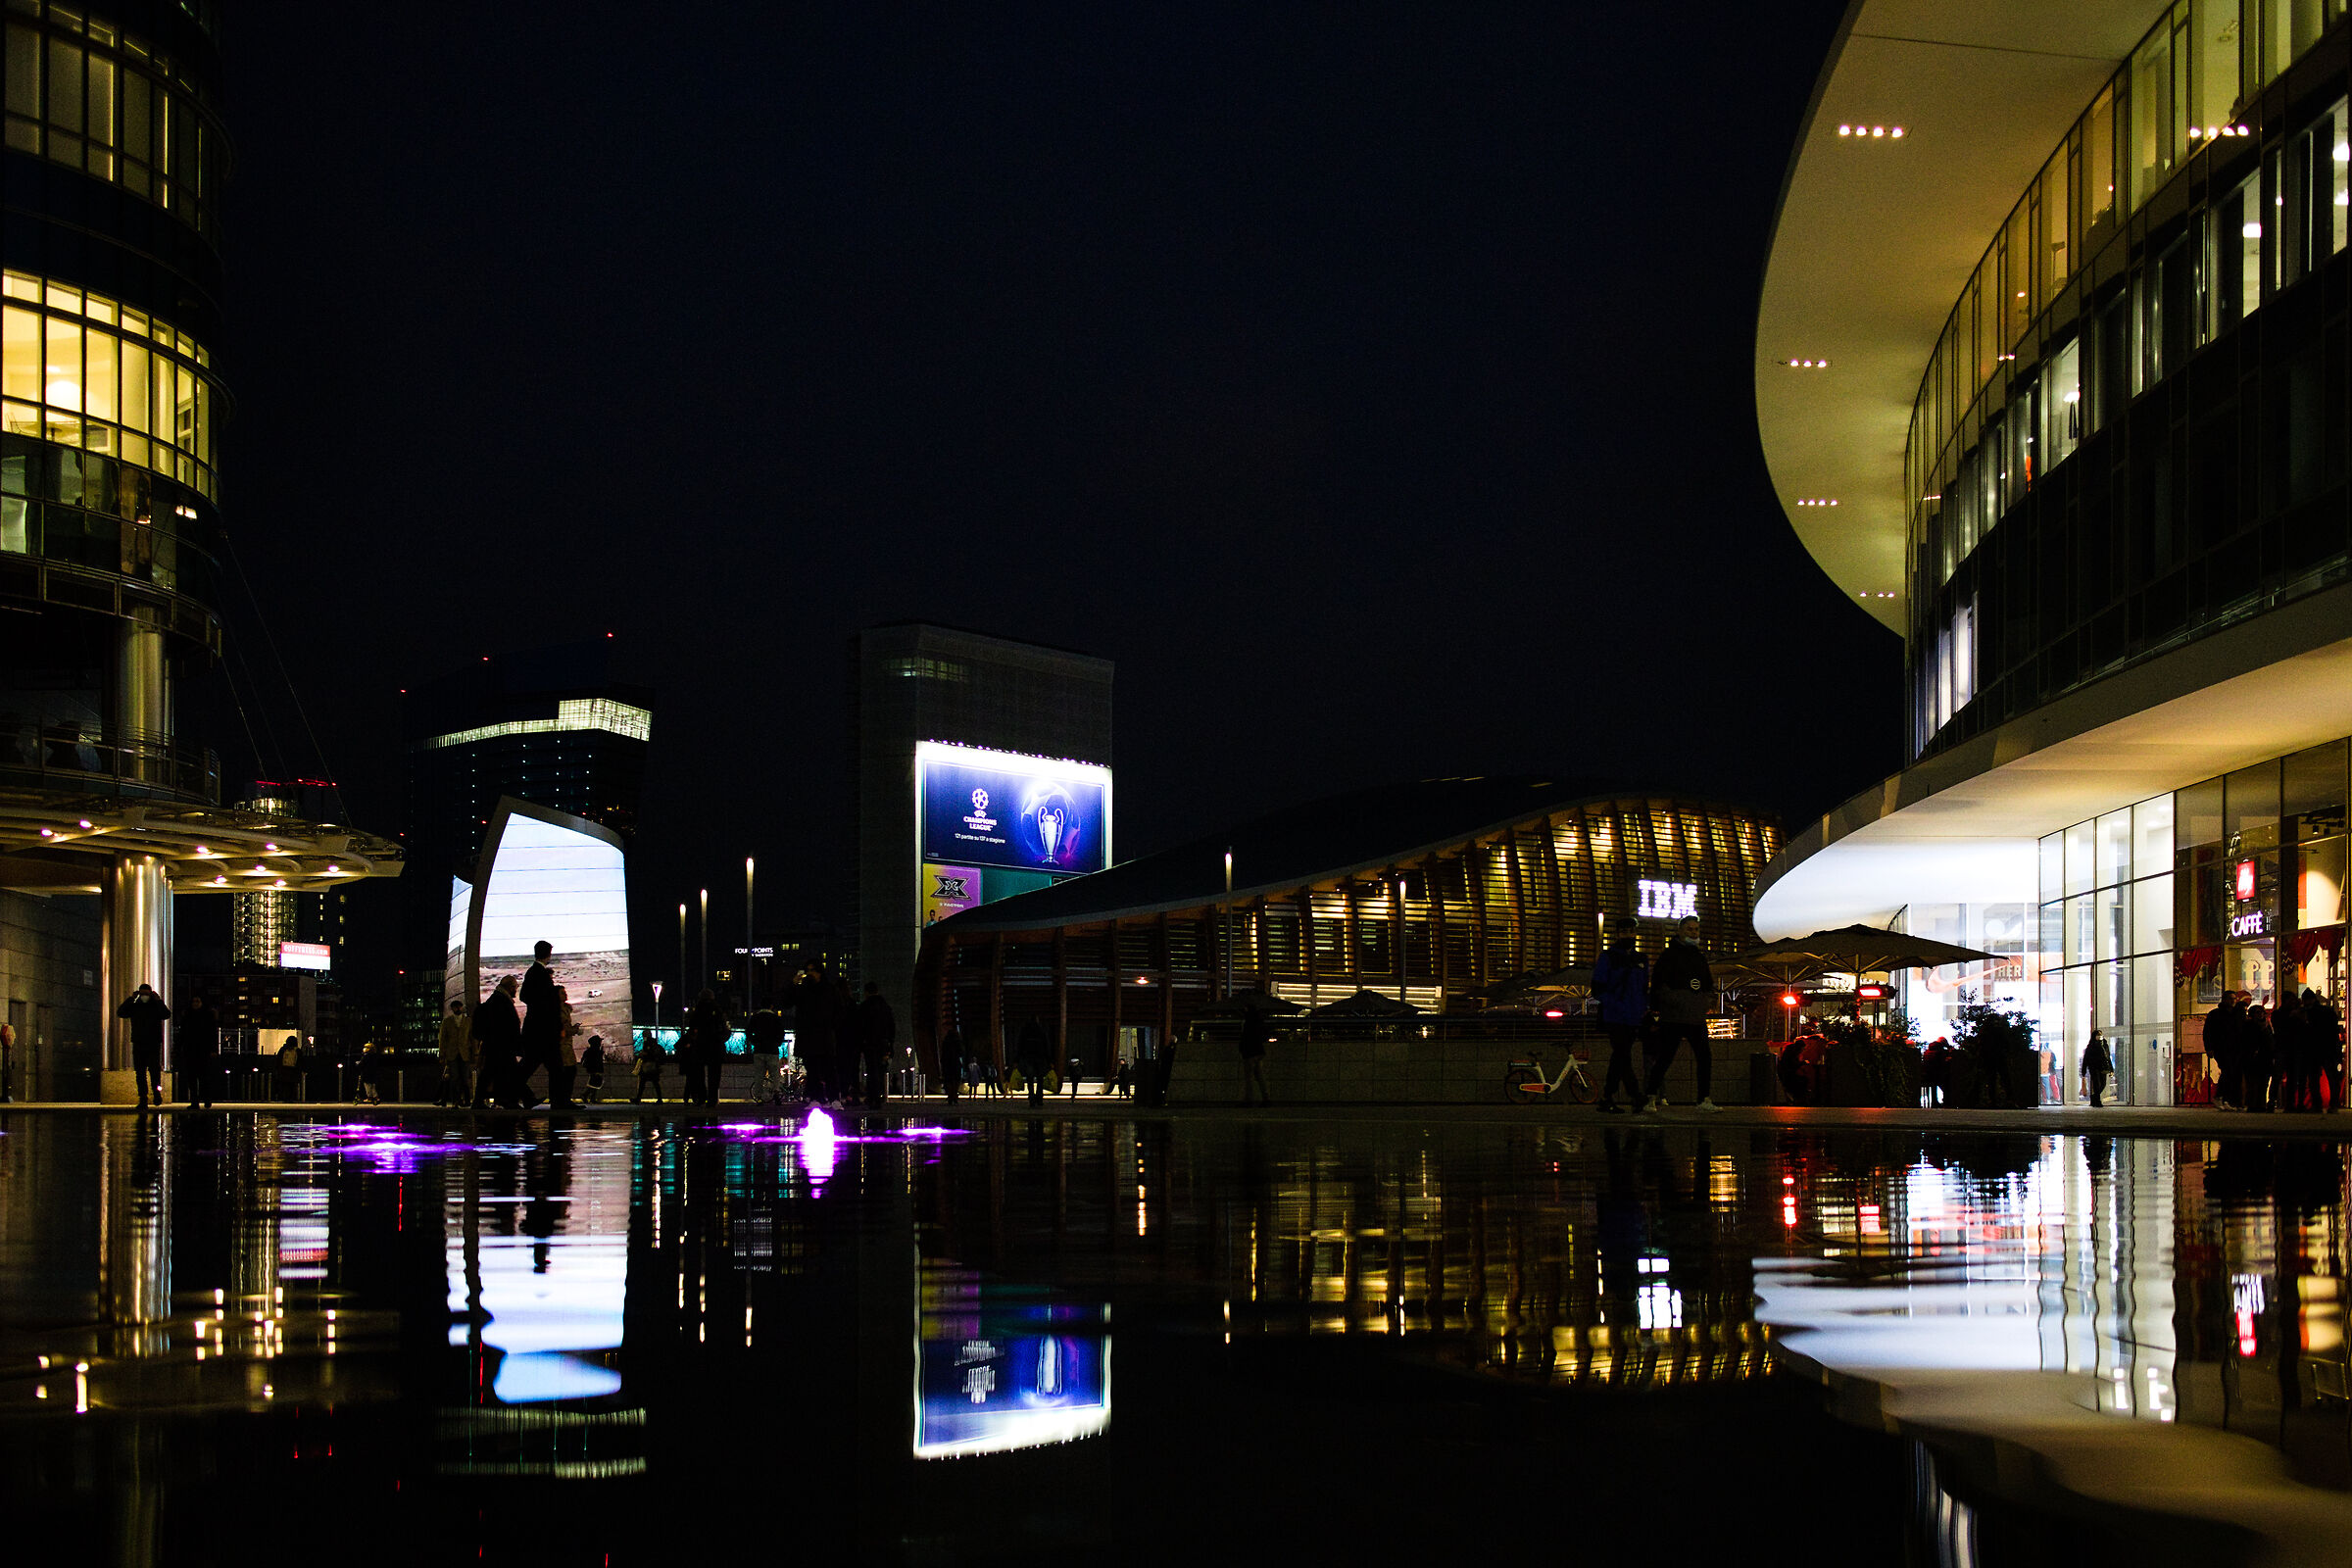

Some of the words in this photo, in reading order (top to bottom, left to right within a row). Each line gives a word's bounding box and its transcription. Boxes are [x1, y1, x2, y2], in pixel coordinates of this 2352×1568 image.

[963, 815, 998, 826] CHAMPIONS
[969, 823, 993, 832] LEAGUE
[1638, 879, 1698, 919] IBM
